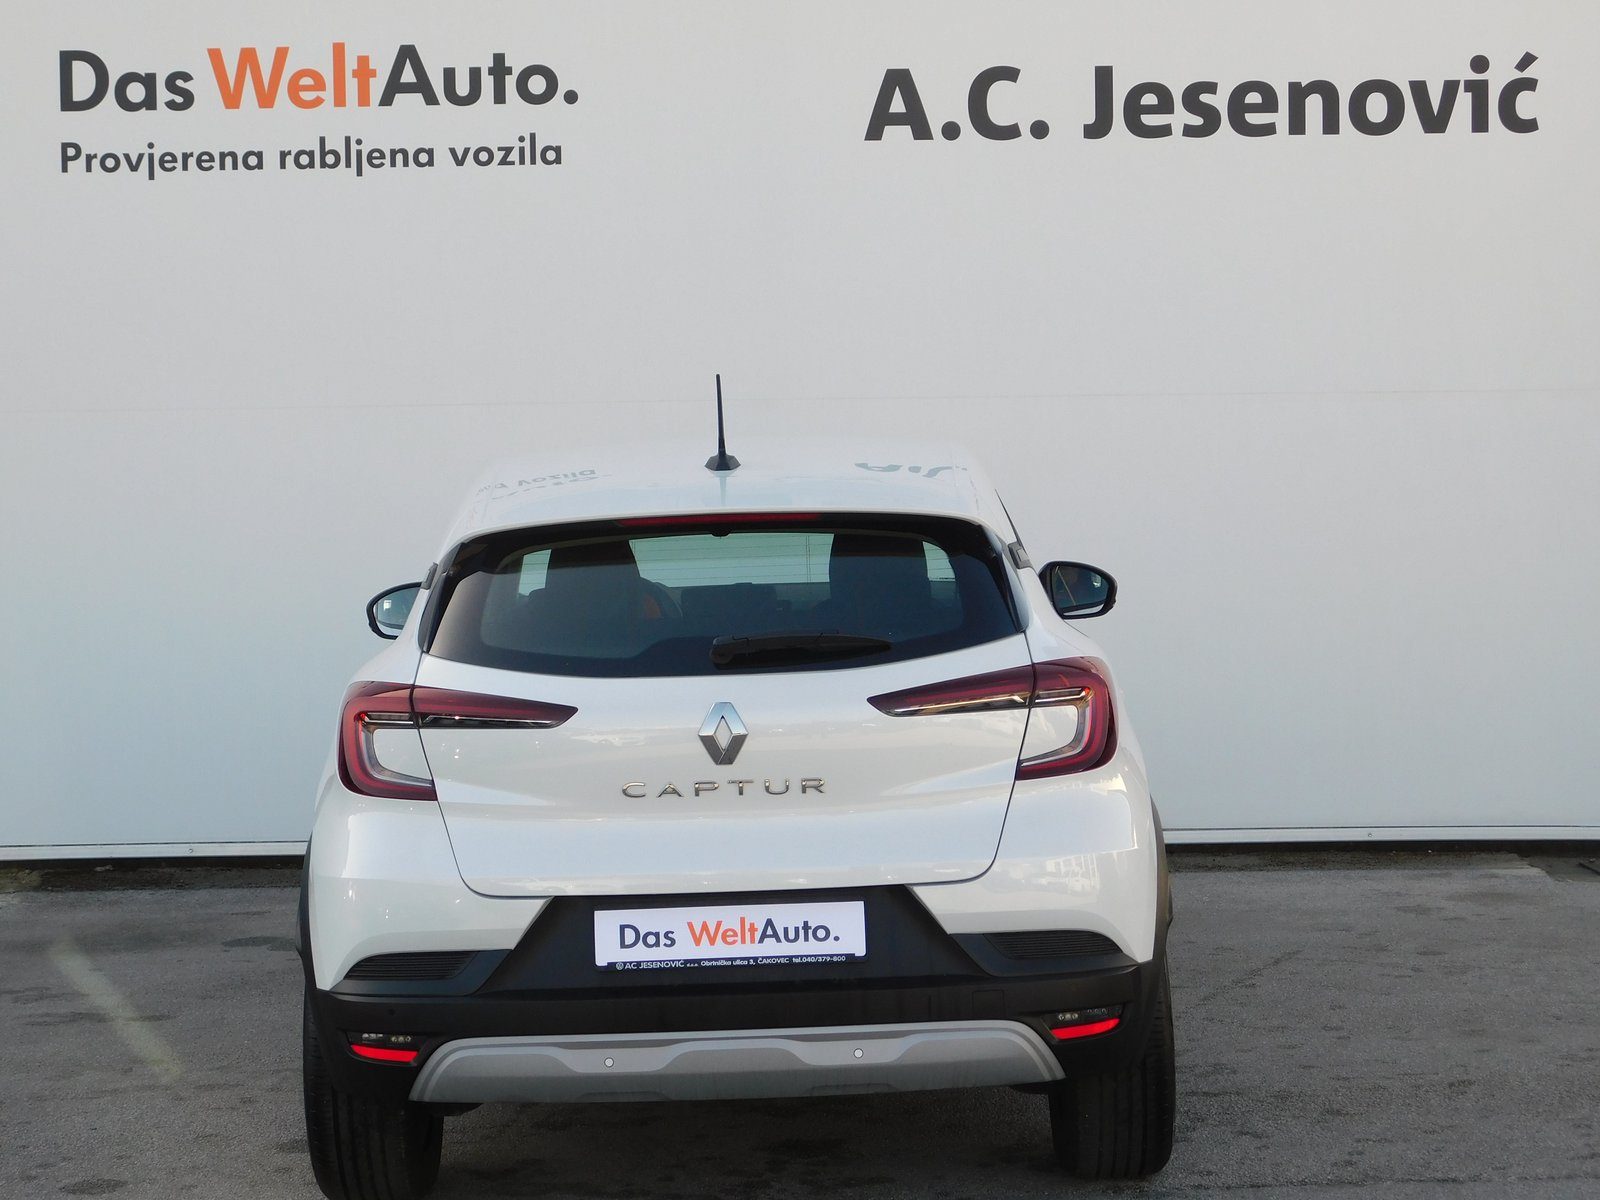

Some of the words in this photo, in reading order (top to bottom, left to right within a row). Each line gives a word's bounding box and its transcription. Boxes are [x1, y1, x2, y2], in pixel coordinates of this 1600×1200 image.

[59, 49, 195, 113] Das
[207, 42, 579, 110] WeltAuto.
[863, 66, 1050, 142] A.C.
[1083, 51, 1540, 140] Jesenović
[60, 141, 264, 181] Provjerena
[279, 136, 435, 177] rabljena
[448, 132, 562, 167] vozila
[621, 778, 826, 798] CAPTUR
[619, 923, 677, 949] Das
[686, 916, 841, 947] WeltAuto.
